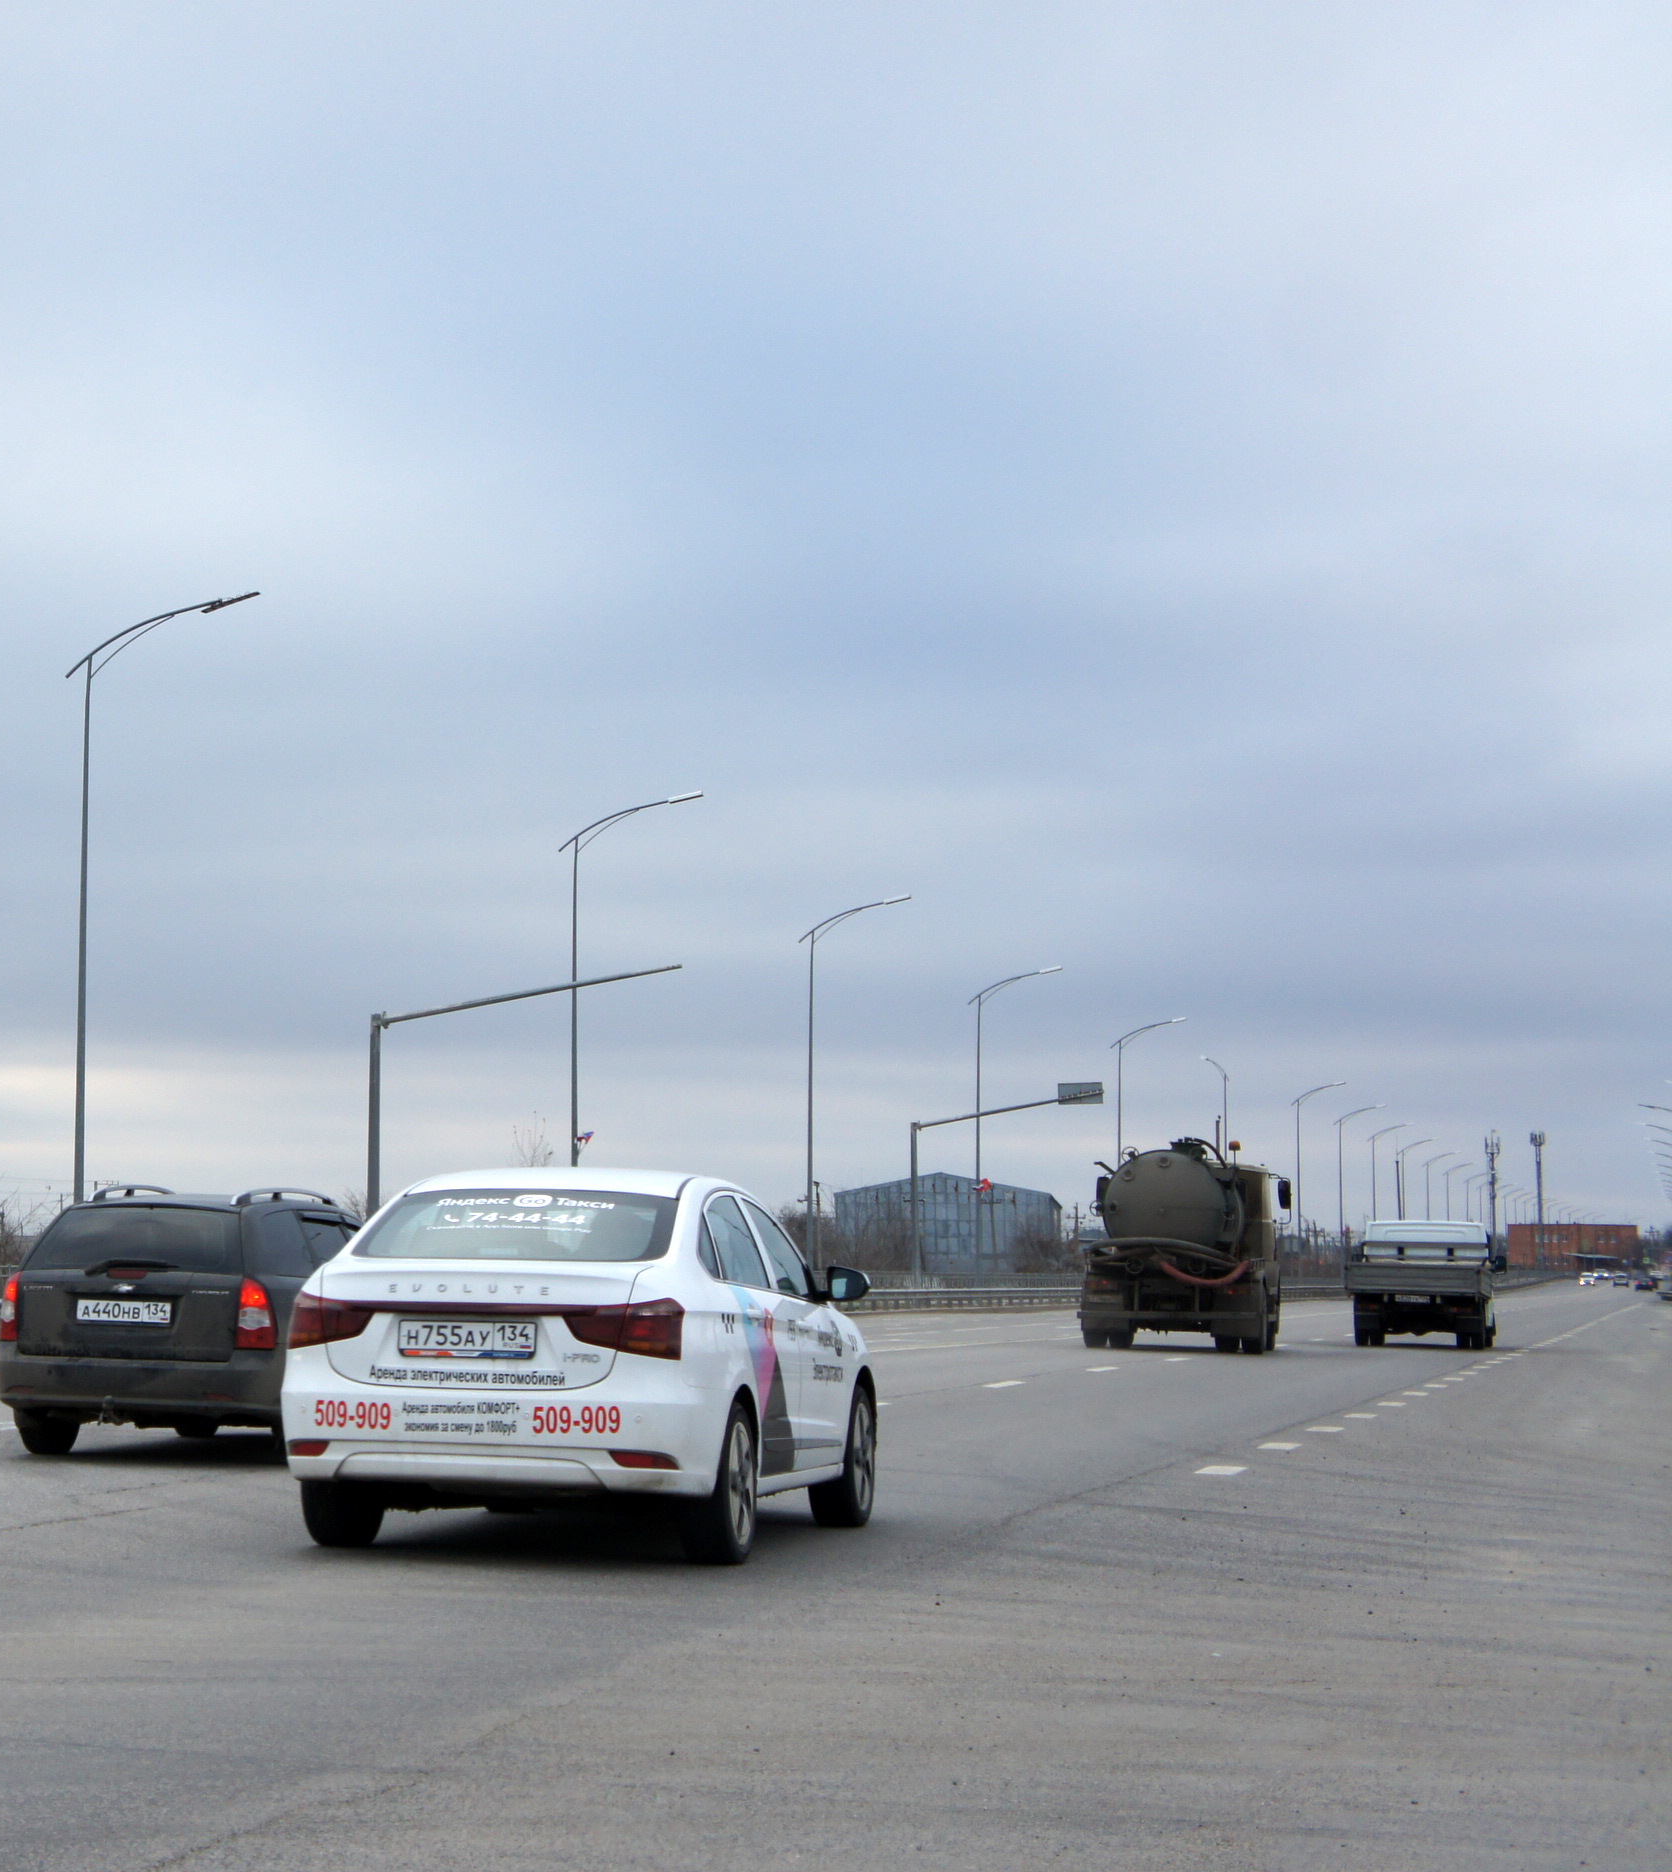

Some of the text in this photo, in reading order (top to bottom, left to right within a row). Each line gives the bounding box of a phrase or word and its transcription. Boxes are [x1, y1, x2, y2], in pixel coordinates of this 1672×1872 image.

[436, 1197, 511, 1208] Яндекс
[556, 1197, 615, 1210] Такси
[466, 1212, 586, 1225] 74-44-44
[388, 1283, 550, 1296] EVOLUTE
[82, 1302, 167, 1319] А440НВ 134
[406, 1325, 530, 1347] Н755АУ 134
[369, 1365, 566, 1387] Аренда электрических автомобилей
[314, 1400, 391, 1430] 509-909
[402, 1402, 521, 1416] Аренда автомобиля КОМФОРТ+
[404, 1420, 517, 1436] экономия за смену до 1800руб
[531, 1405, 622, 1435] 509-909
